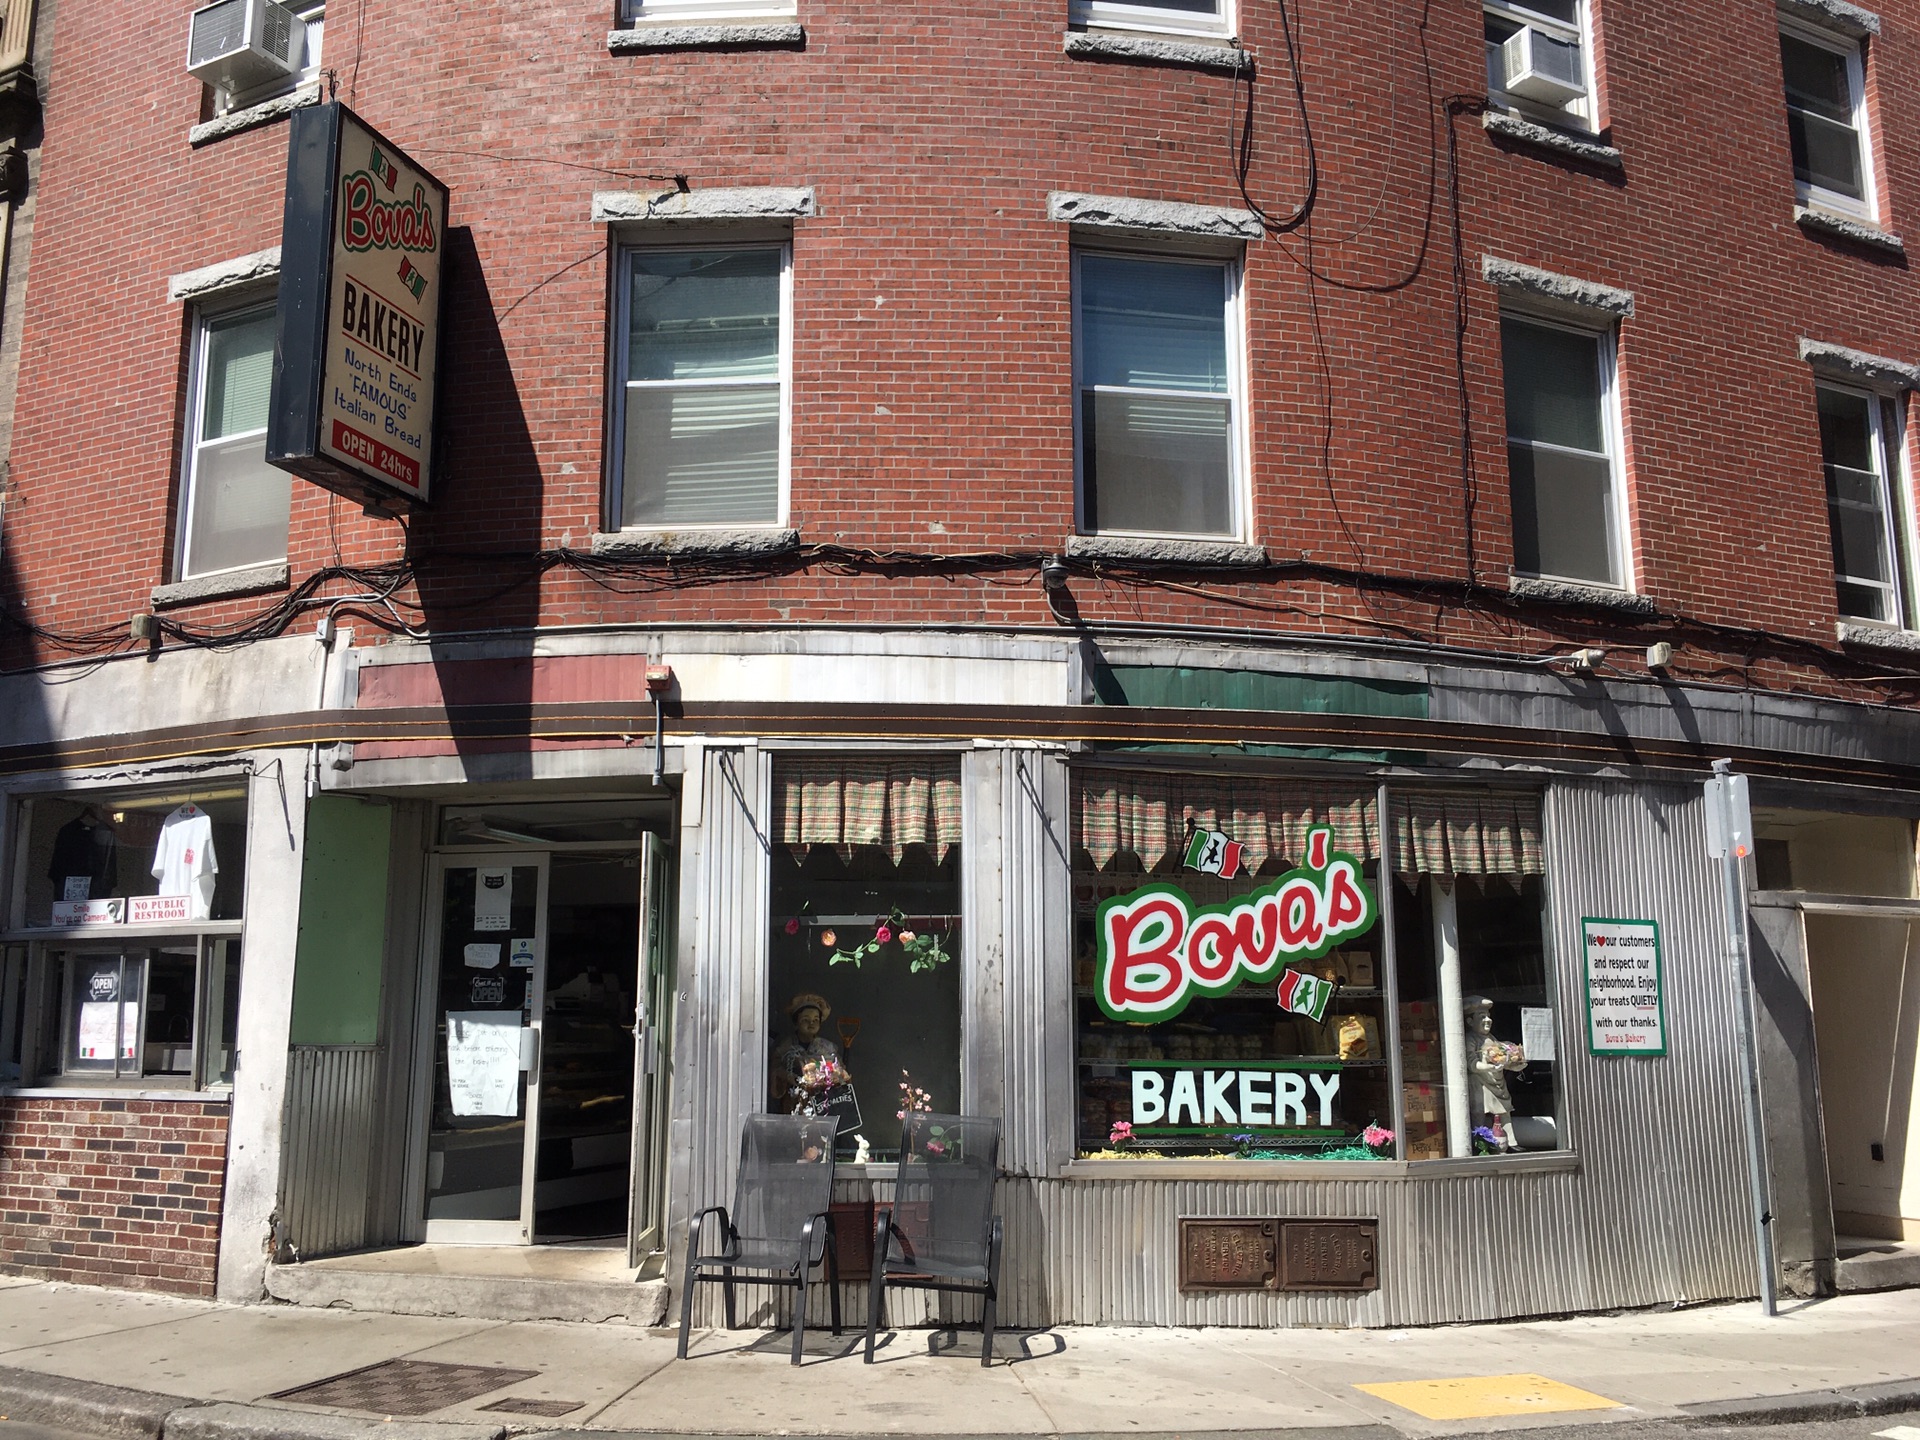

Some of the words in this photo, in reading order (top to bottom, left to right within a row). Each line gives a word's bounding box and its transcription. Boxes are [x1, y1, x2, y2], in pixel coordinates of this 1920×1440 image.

[343, 170, 437, 252] Bova's
[342, 280, 425, 373] BAKERY
[344, 347, 382, 383] North
[389, 372, 417, 403] End's
[334, 387, 376, 426] Italian
[385, 415, 422, 450] Bread
[341, 429, 375, 464] OPEN
[380, 450, 413, 482] 24hrs
[73, 904, 90, 913] Smile
[134, 901, 148, 911] NO
[151, 899, 186, 909] PUBLIC
[83, 913, 108, 922] Camera!
[134, 909, 186, 920] RESTROOM
[1104, 826, 1370, 1013] Bova's
[1587, 933, 1597, 947] We
[1606, 936, 1617, 947] our
[1619, 934, 1655, 948] customers
[1594, 956, 1607, 969] and
[1609, 957, 1635, 971] respect
[1636, 959, 1649, 969] our
[93, 978, 113, 990] OPEN
[1589, 976, 1636, 992] neighborhood.
[1638, 976, 1657, 992] Enjoy
[474, 988, 502, 1001] OPEN
[1590, 997, 1606, 1009] your
[1608, 996, 1630, 1007] treats
[1630, 995, 1658, 1009] QUIETLY
[1595, 1016, 1613, 1028] with
[1615, 1018, 1628, 1028] our
[1630, 1016, 1658, 1028] thanks.
[1605, 1033, 1624, 1044] Bova's
[1624, 1034, 1647, 1045] Bakery
[1132, 1070, 1340, 1127] BAKERY
[1231, 1232, 1244, 1277] ELECTRIC
[1320, 1236, 1329, 1273] SERVICE
[1330, 1233, 1342, 1277] ELECTRIC
